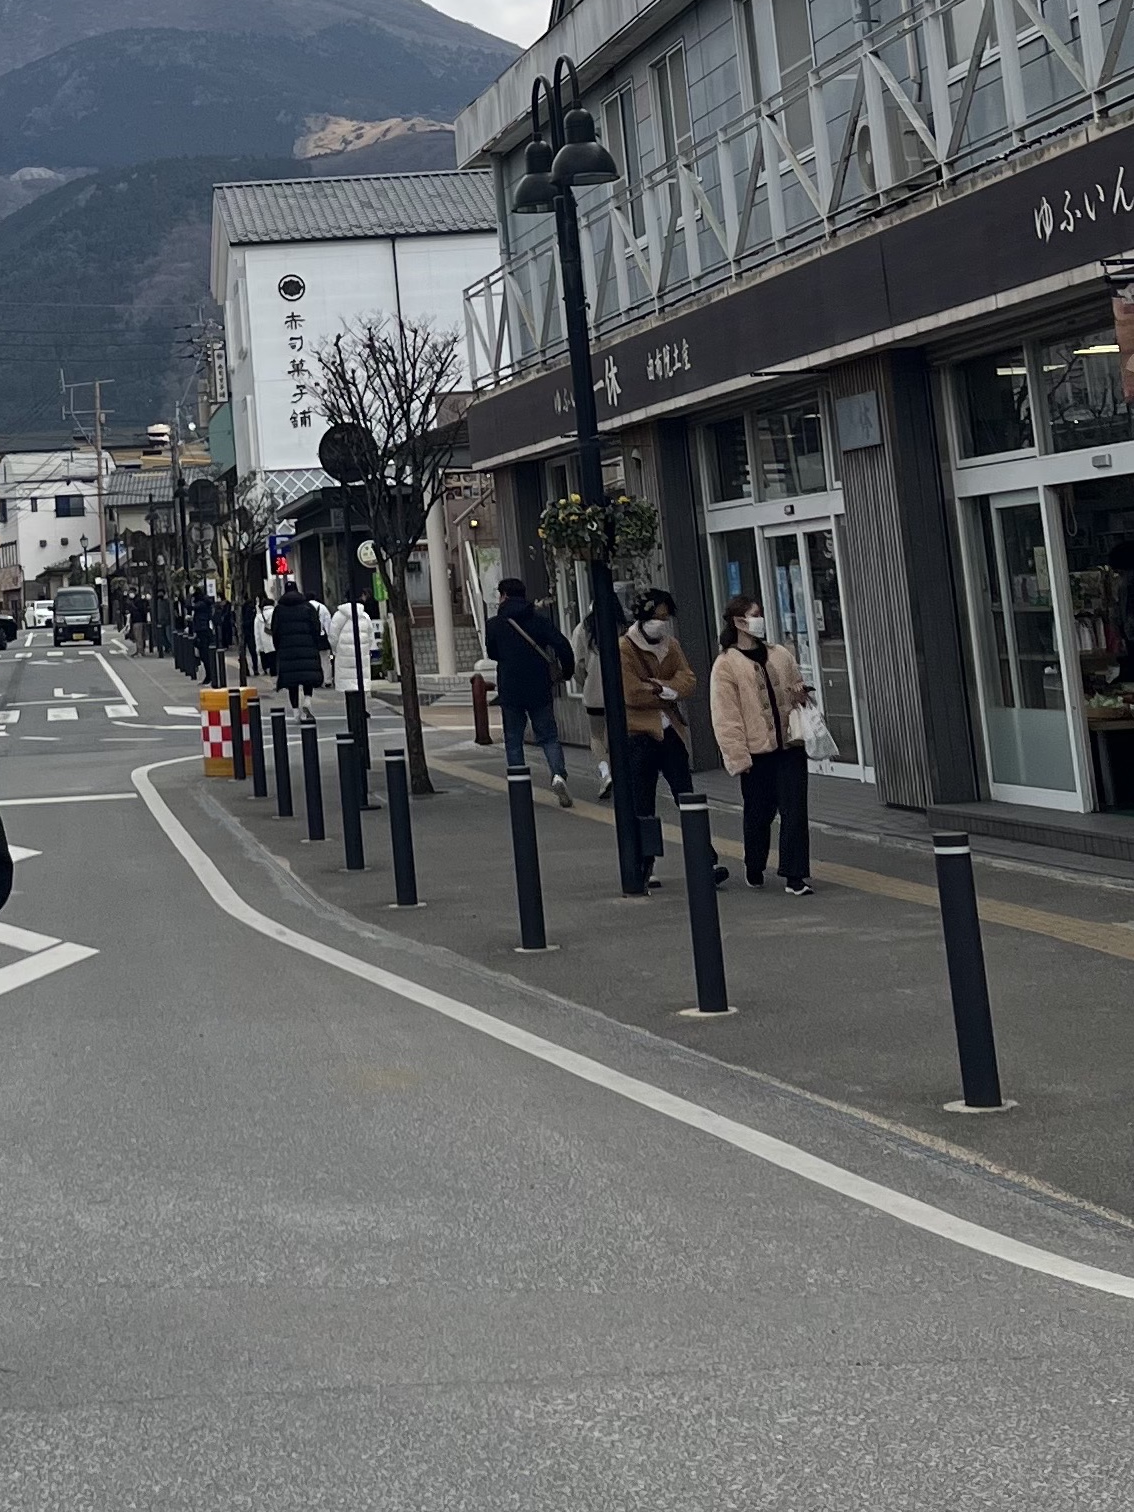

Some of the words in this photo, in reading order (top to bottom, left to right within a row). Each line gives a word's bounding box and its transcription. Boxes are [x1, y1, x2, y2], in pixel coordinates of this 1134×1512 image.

[284, 311, 313, 429] 赤司菓子舗
